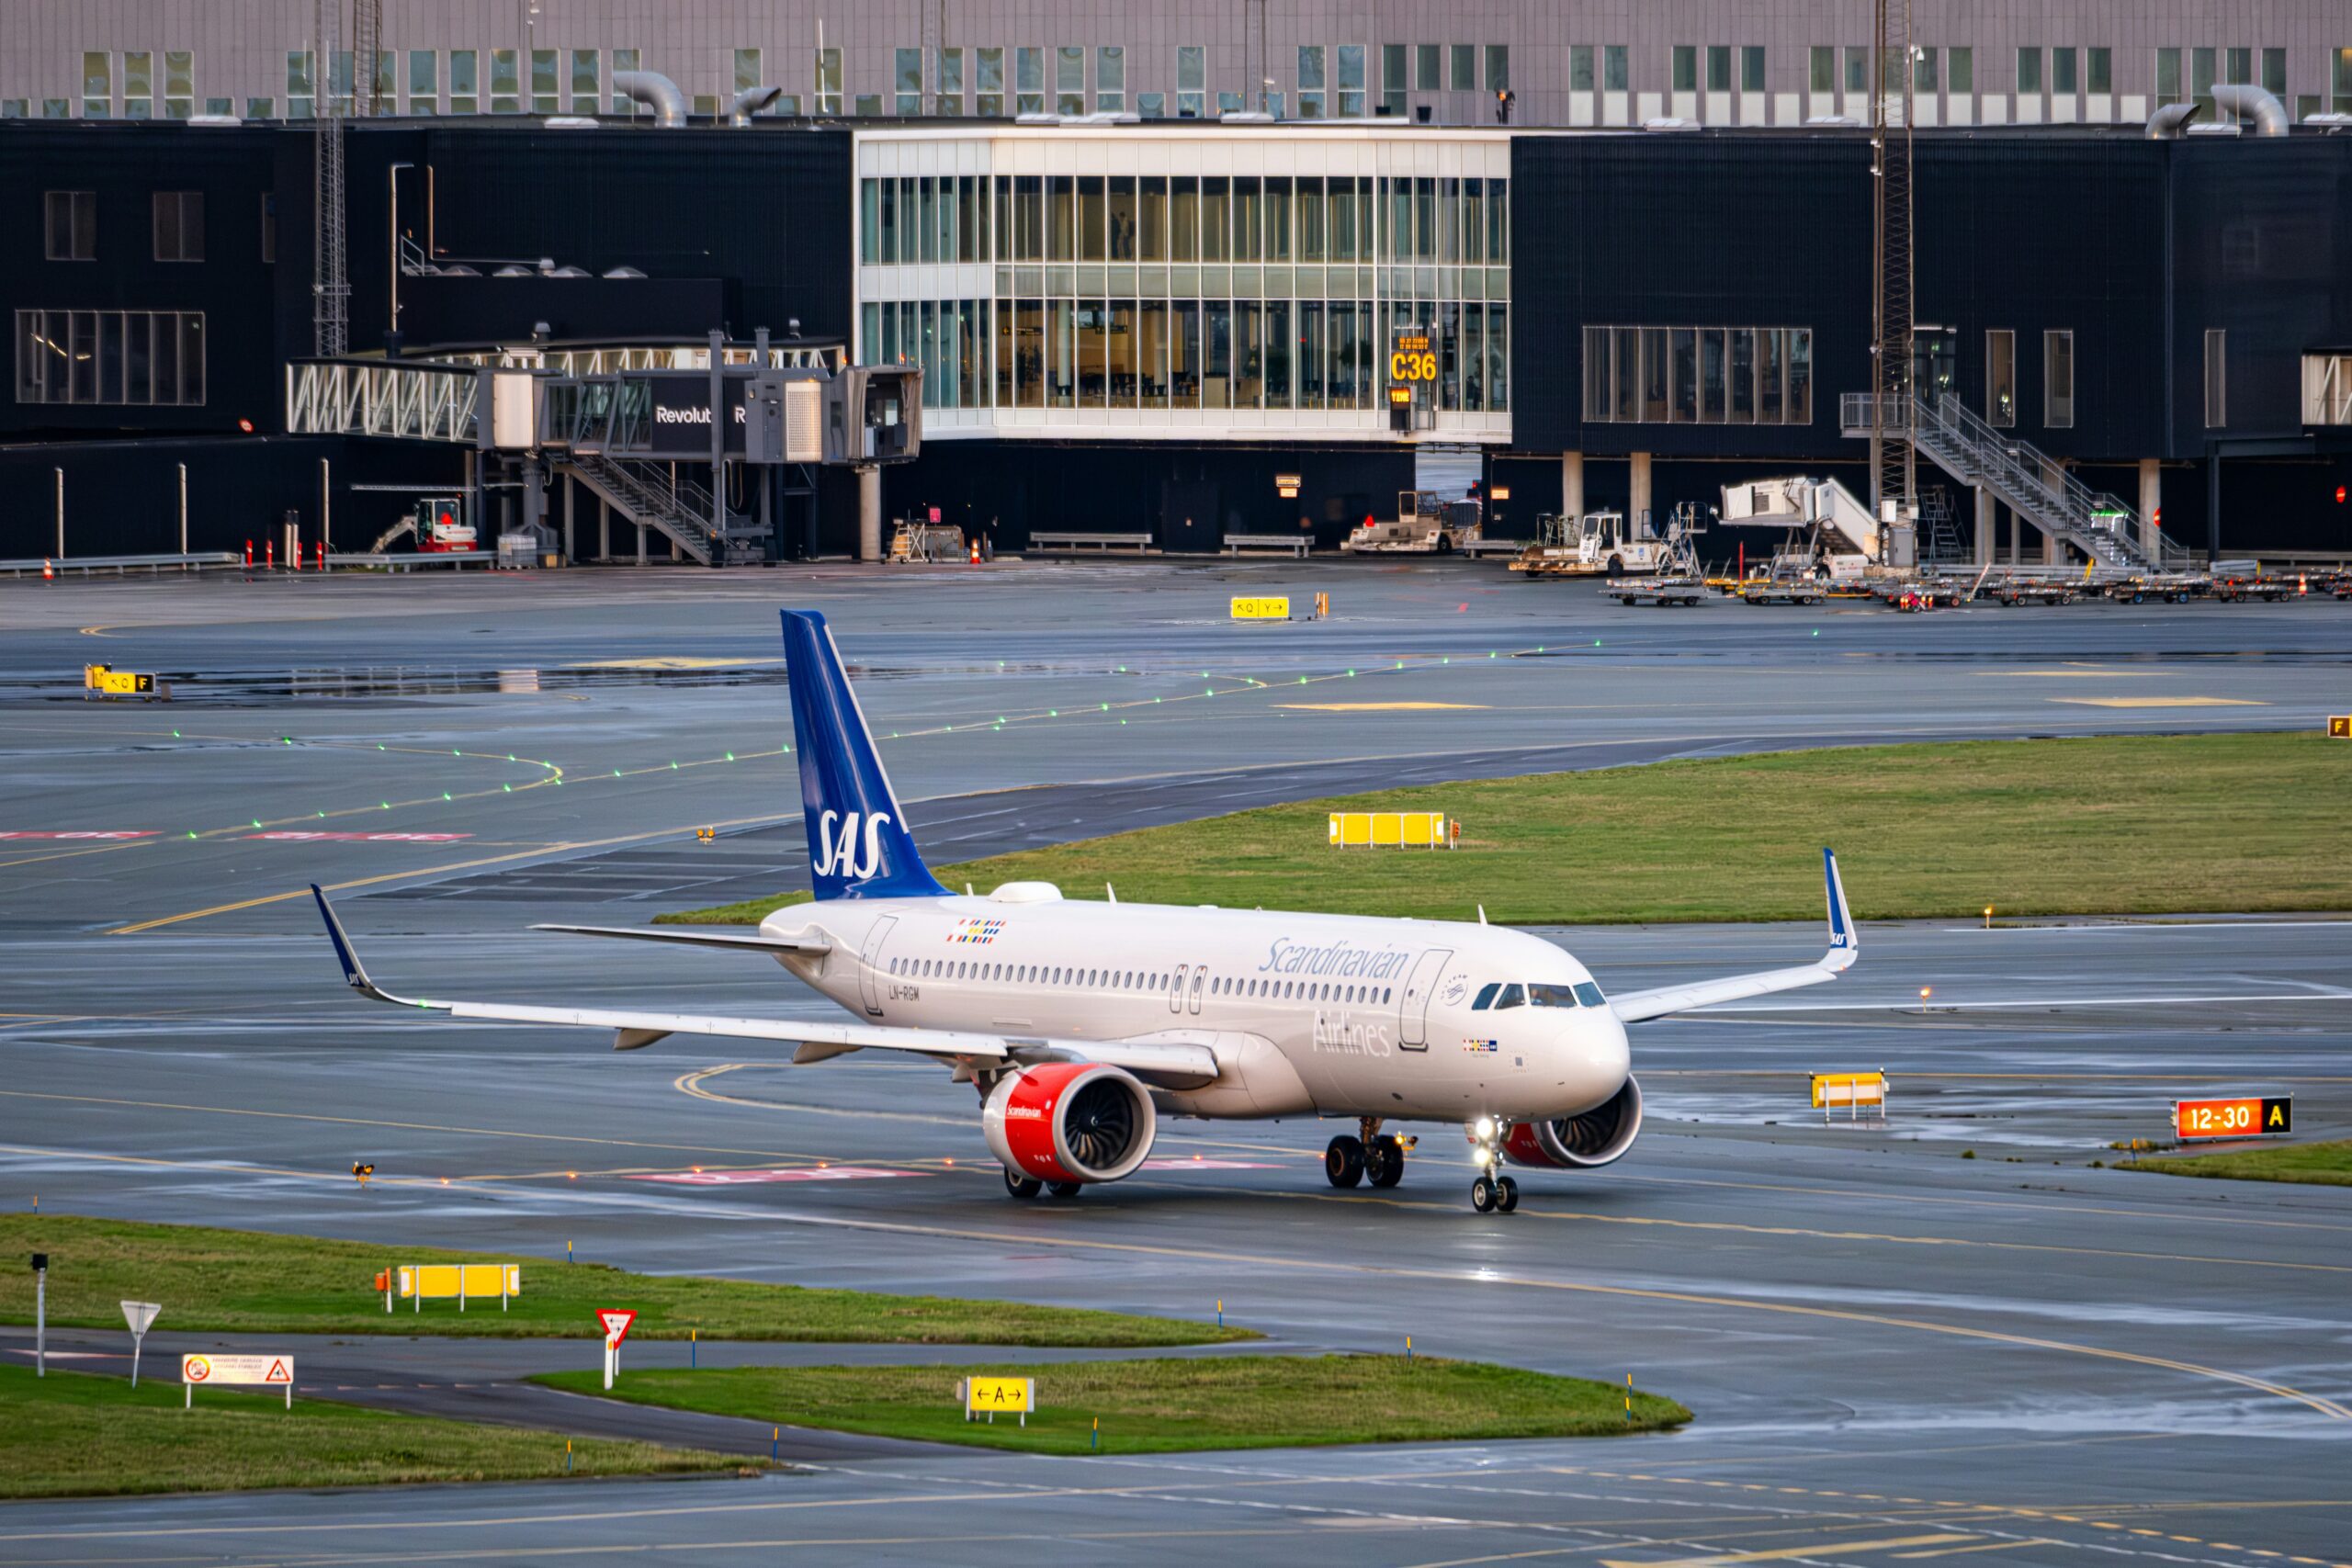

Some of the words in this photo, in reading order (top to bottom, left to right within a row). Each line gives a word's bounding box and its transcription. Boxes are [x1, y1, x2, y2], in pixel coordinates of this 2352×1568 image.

[1391, 353, 1436, 380] C36
[656, 405, 712, 423] Revolut
[1246, 603, 1254, 614] Q
[1264, 603, 1271, 614] Y
[139, 677, 148, 690] F
[2335, 720, 2344, 734] F
[813, 809, 891, 879] SAS
[1258, 937, 1409, 980] Scandinavian
[888, 985, 920, 1001] LN-RGM
[1313, 1009, 1391, 1057] Airlines
[1007, 1104, 1042, 1118] Scandinavian
[2191, 1107, 2249, 1129] 12-30
[2268, 1105, 2283, 1126] A
[994, 1386, 1005, 1404] A
